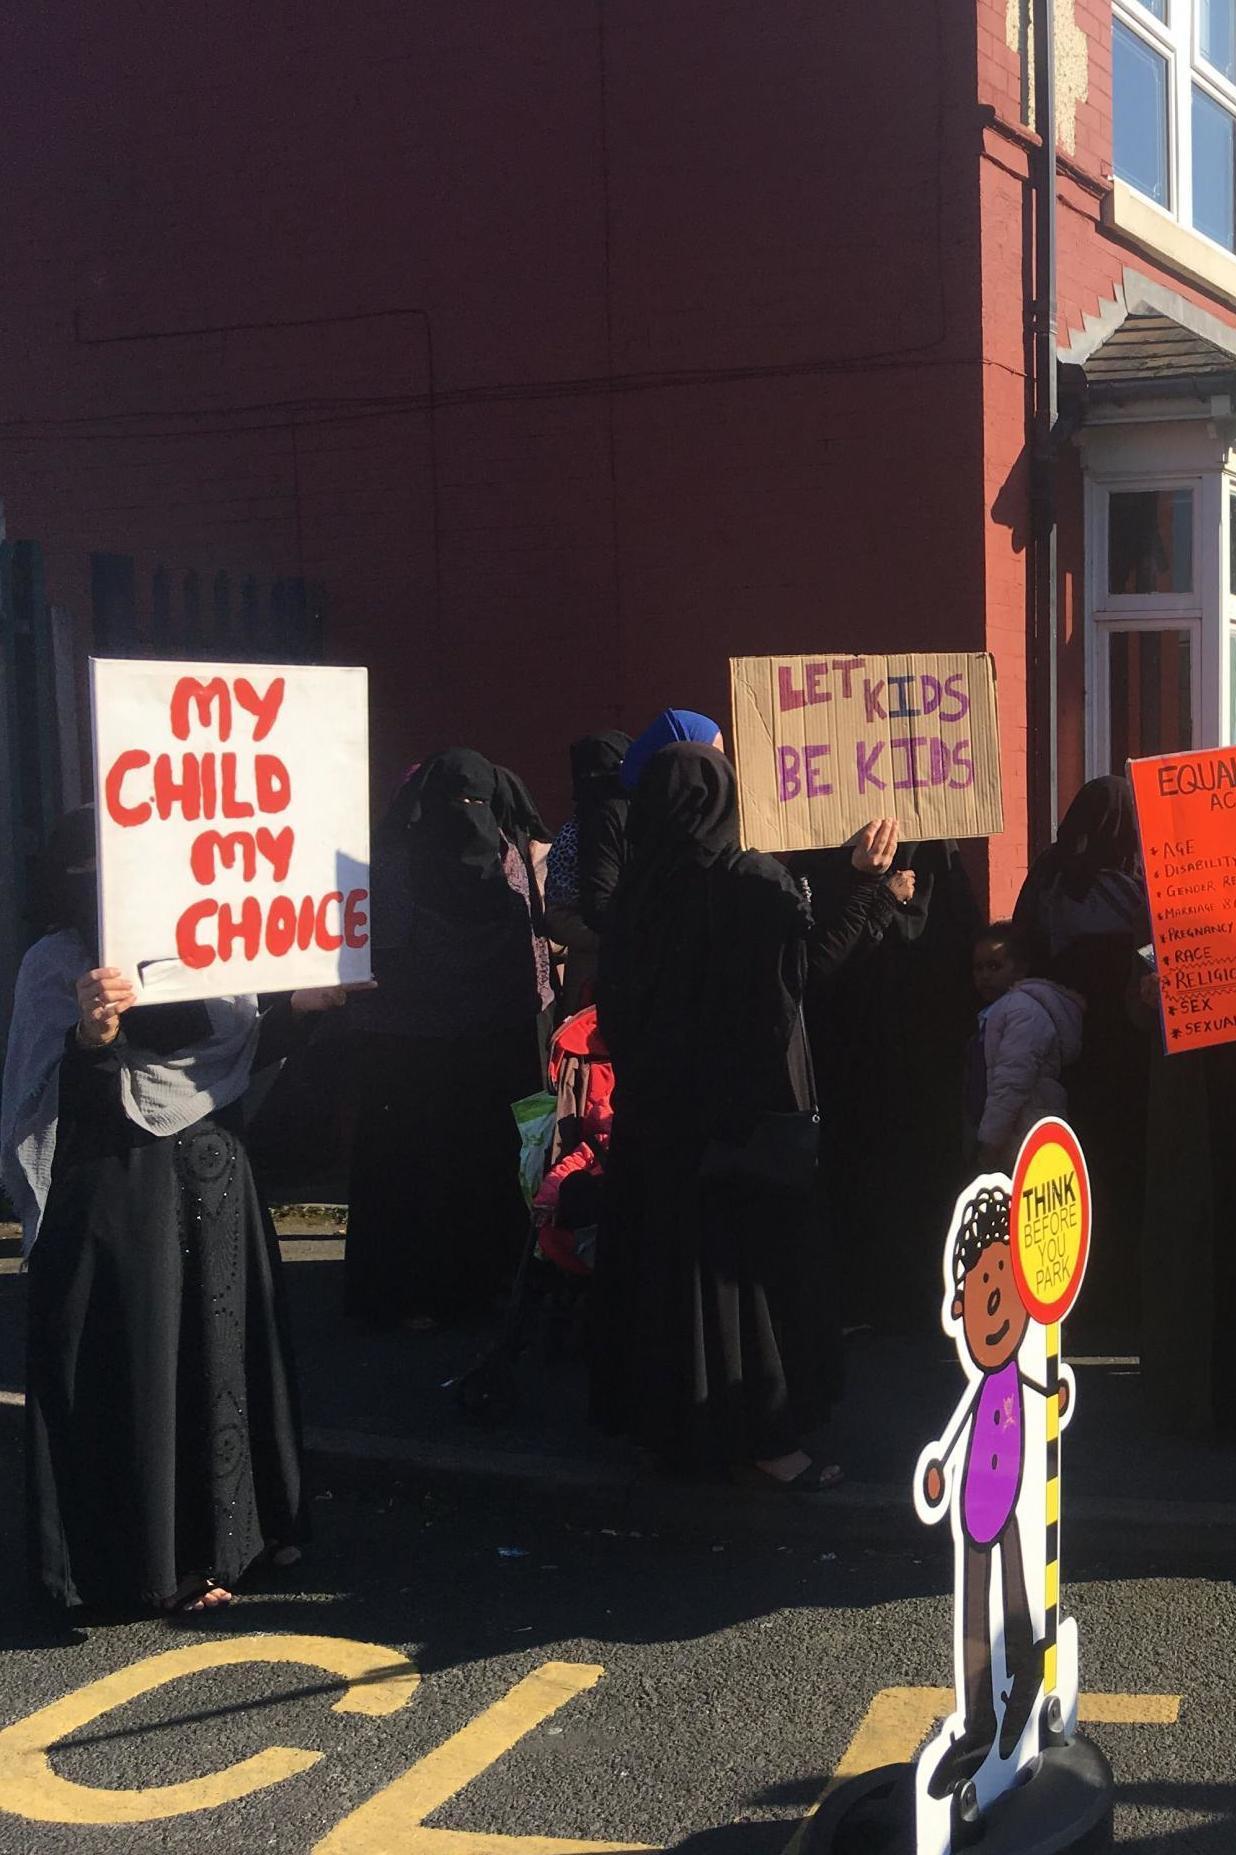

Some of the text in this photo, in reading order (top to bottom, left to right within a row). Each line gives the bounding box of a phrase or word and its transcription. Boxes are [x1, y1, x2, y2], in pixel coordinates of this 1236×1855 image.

[170, 677, 285, 742] MY
[778, 658, 970, 723] LET KIDS
[105, 749, 291, 827] CHILD
[778, 736, 974, 802] BE KIDS
[190, 826, 295, 885] MY
[1163, 839, 1195, 859] AGE
[1166, 882, 1216, 898] GENDER
[176, 888, 369, 970] CHOICE
[1165, 903, 1216, 920] MARRIAGE
[1168, 921, 1234, 942] PREGNANCY
[1174, 946, 1212, 963] RACE
[1180, 997, 1213, 1015] SEX
[1022, 1170, 1077, 1222] THINK
[1024, 1203, 1078, 1249] BEFORE
[1038, 1233, 1066, 1267] YOU
[1035, 1257, 1071, 1295] PARK
